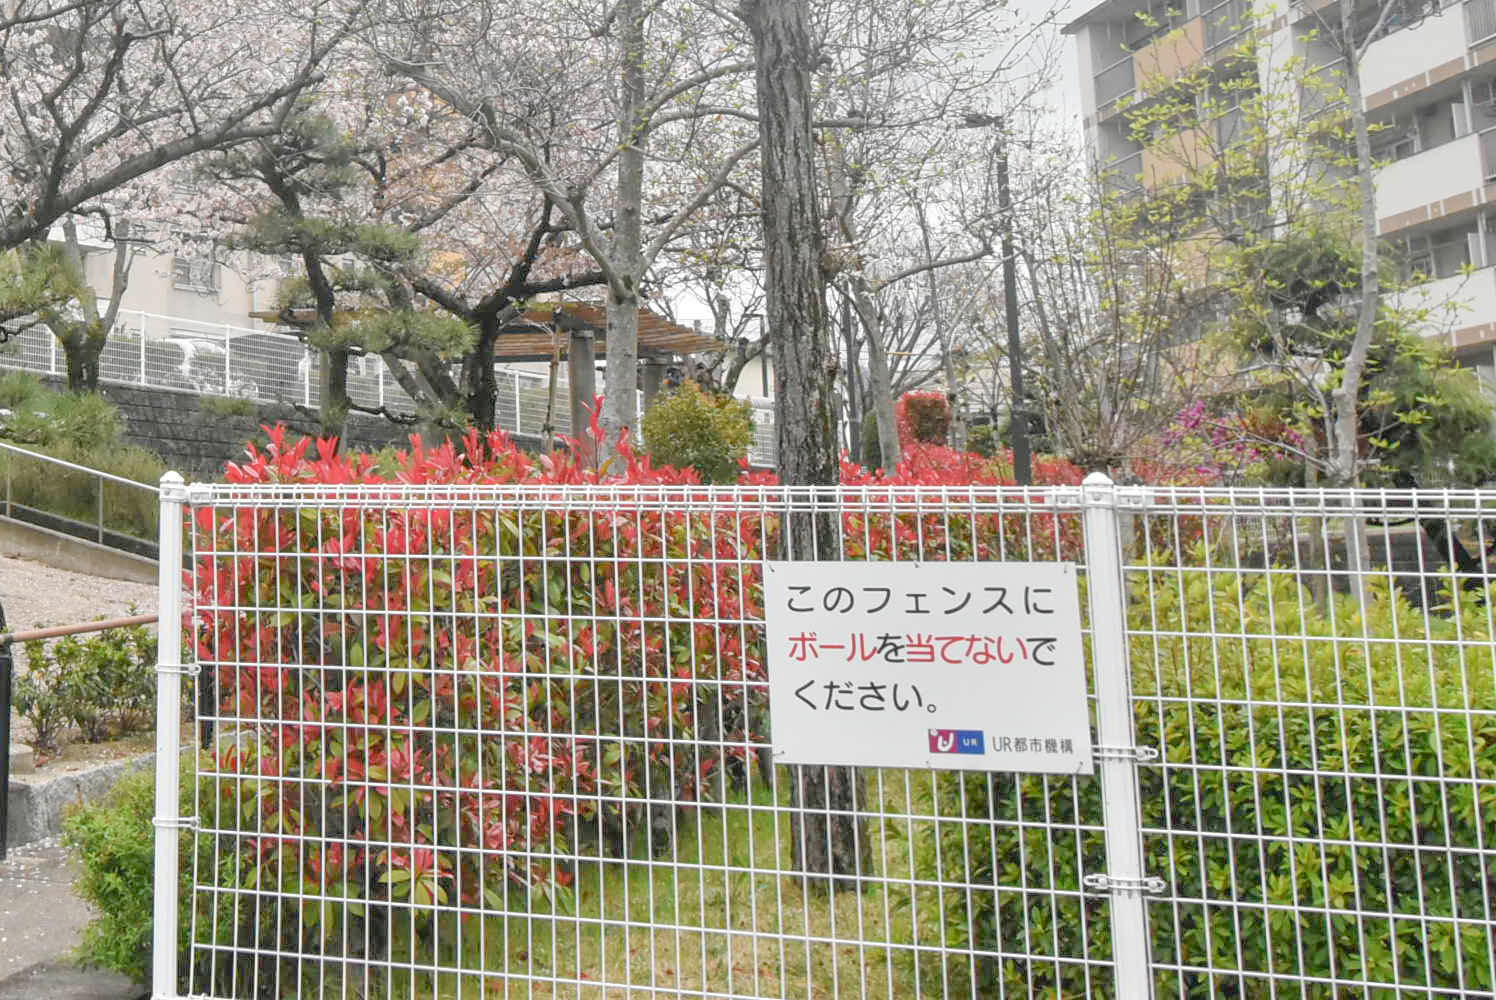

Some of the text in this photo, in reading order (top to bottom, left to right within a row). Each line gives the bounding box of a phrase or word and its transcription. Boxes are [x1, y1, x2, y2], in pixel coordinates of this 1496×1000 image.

[787, 585, 1055, 616] このフェンスに
[787, 631, 1058, 667] ボールを当てないで
[794, 679, 938, 714] ください。
[991, 735, 1075, 755] UR都市機構
